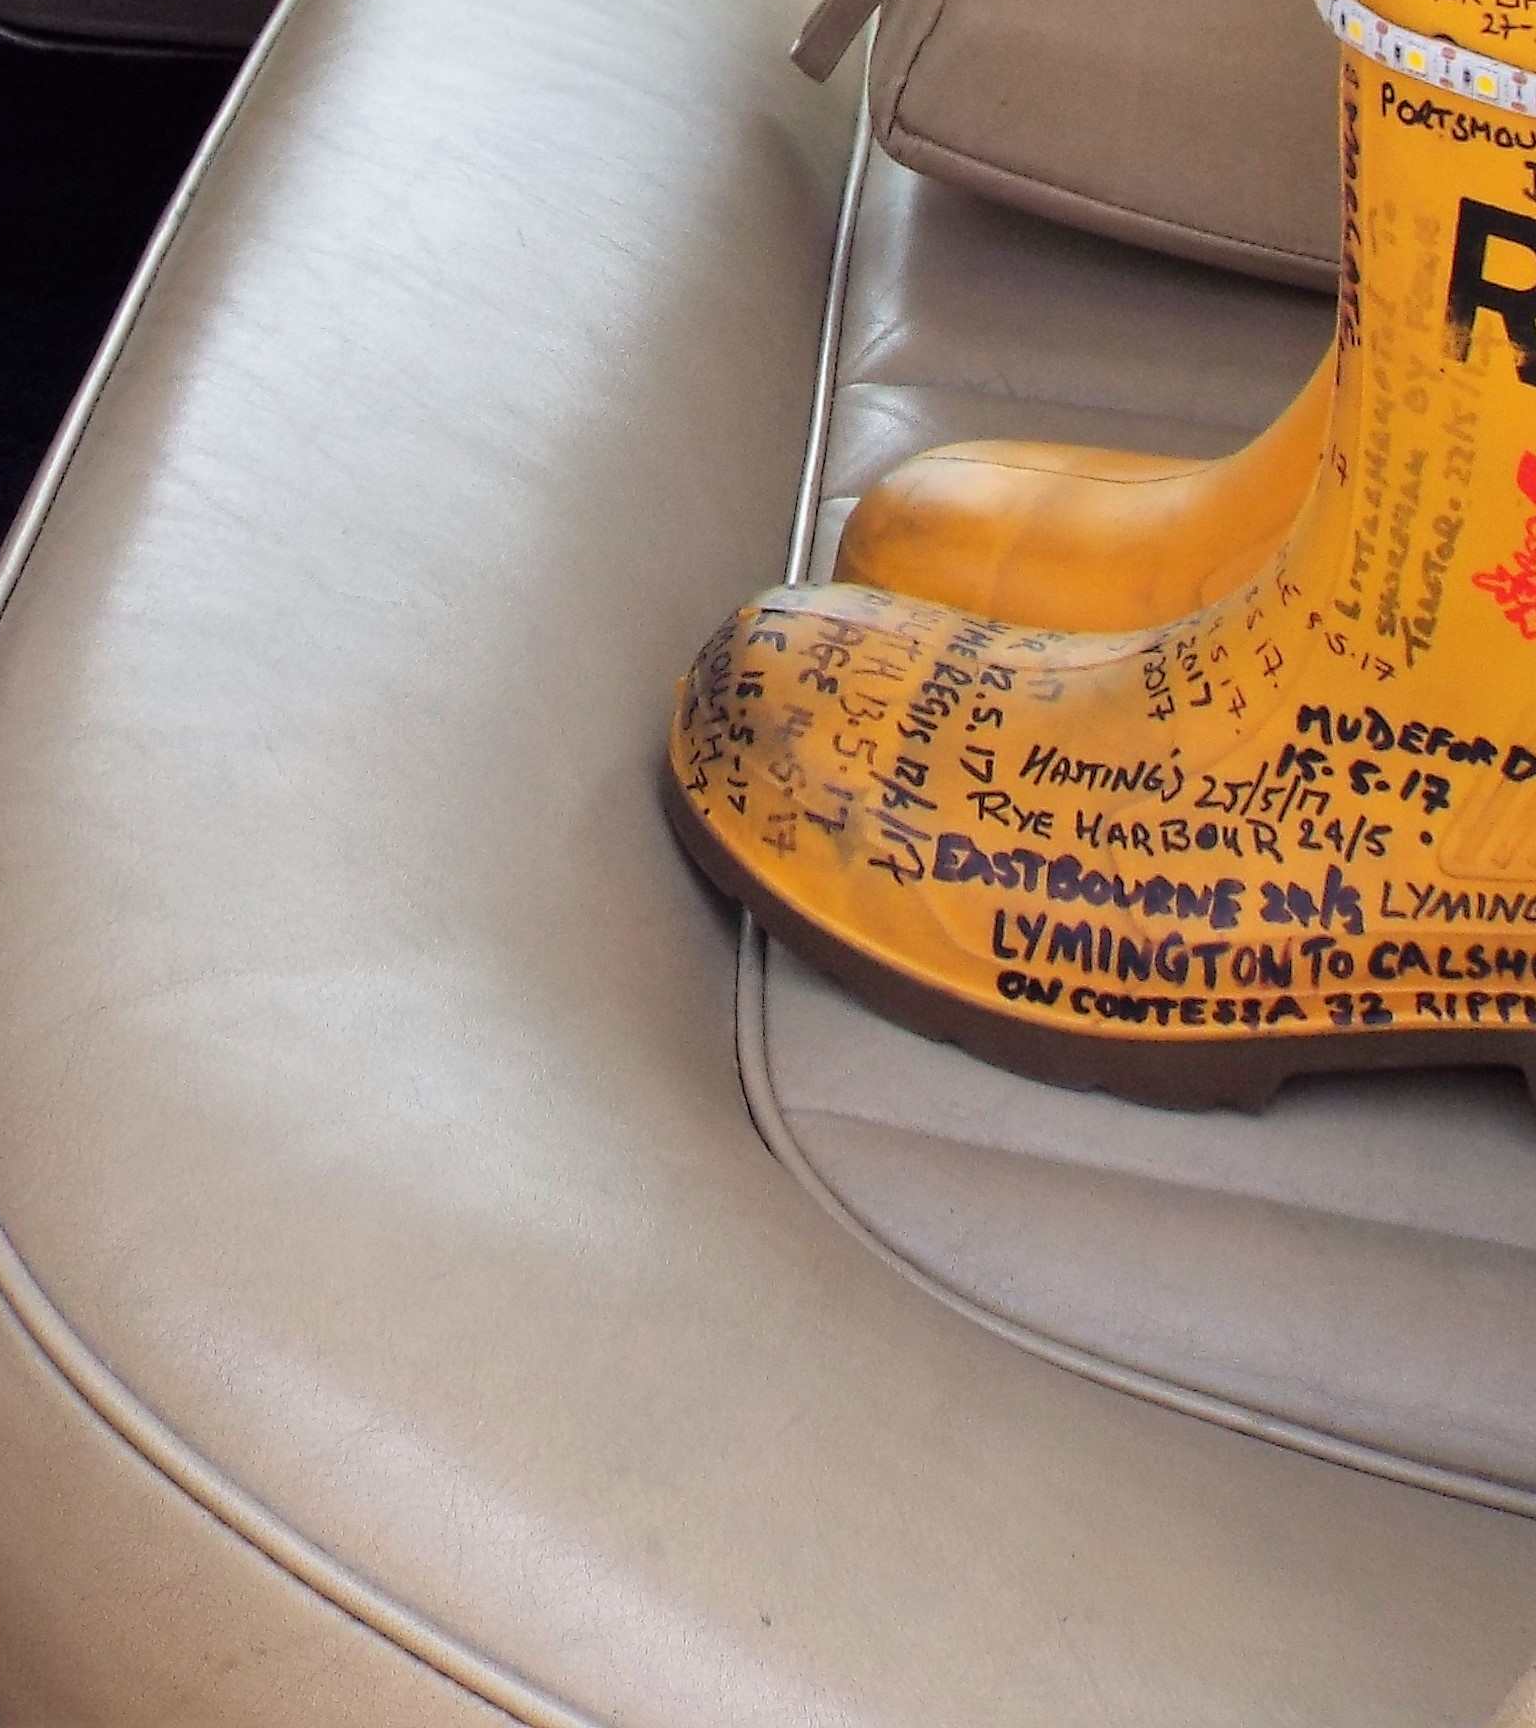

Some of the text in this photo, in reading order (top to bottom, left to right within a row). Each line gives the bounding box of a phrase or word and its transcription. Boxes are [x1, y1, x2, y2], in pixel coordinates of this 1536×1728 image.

[967, 791, 1054, 840] RYE
[1074, 808, 1283, 863] HARBOUR
[932, 832, 1247, 931] EASTBOURNE
[992, 908, 1294, 990] LYMINGTON
[1300, 935, 1355, 985] TO
[996, 969, 1064, 1006] ON
[1070, 986, 1308, 1028] CONTESSA
